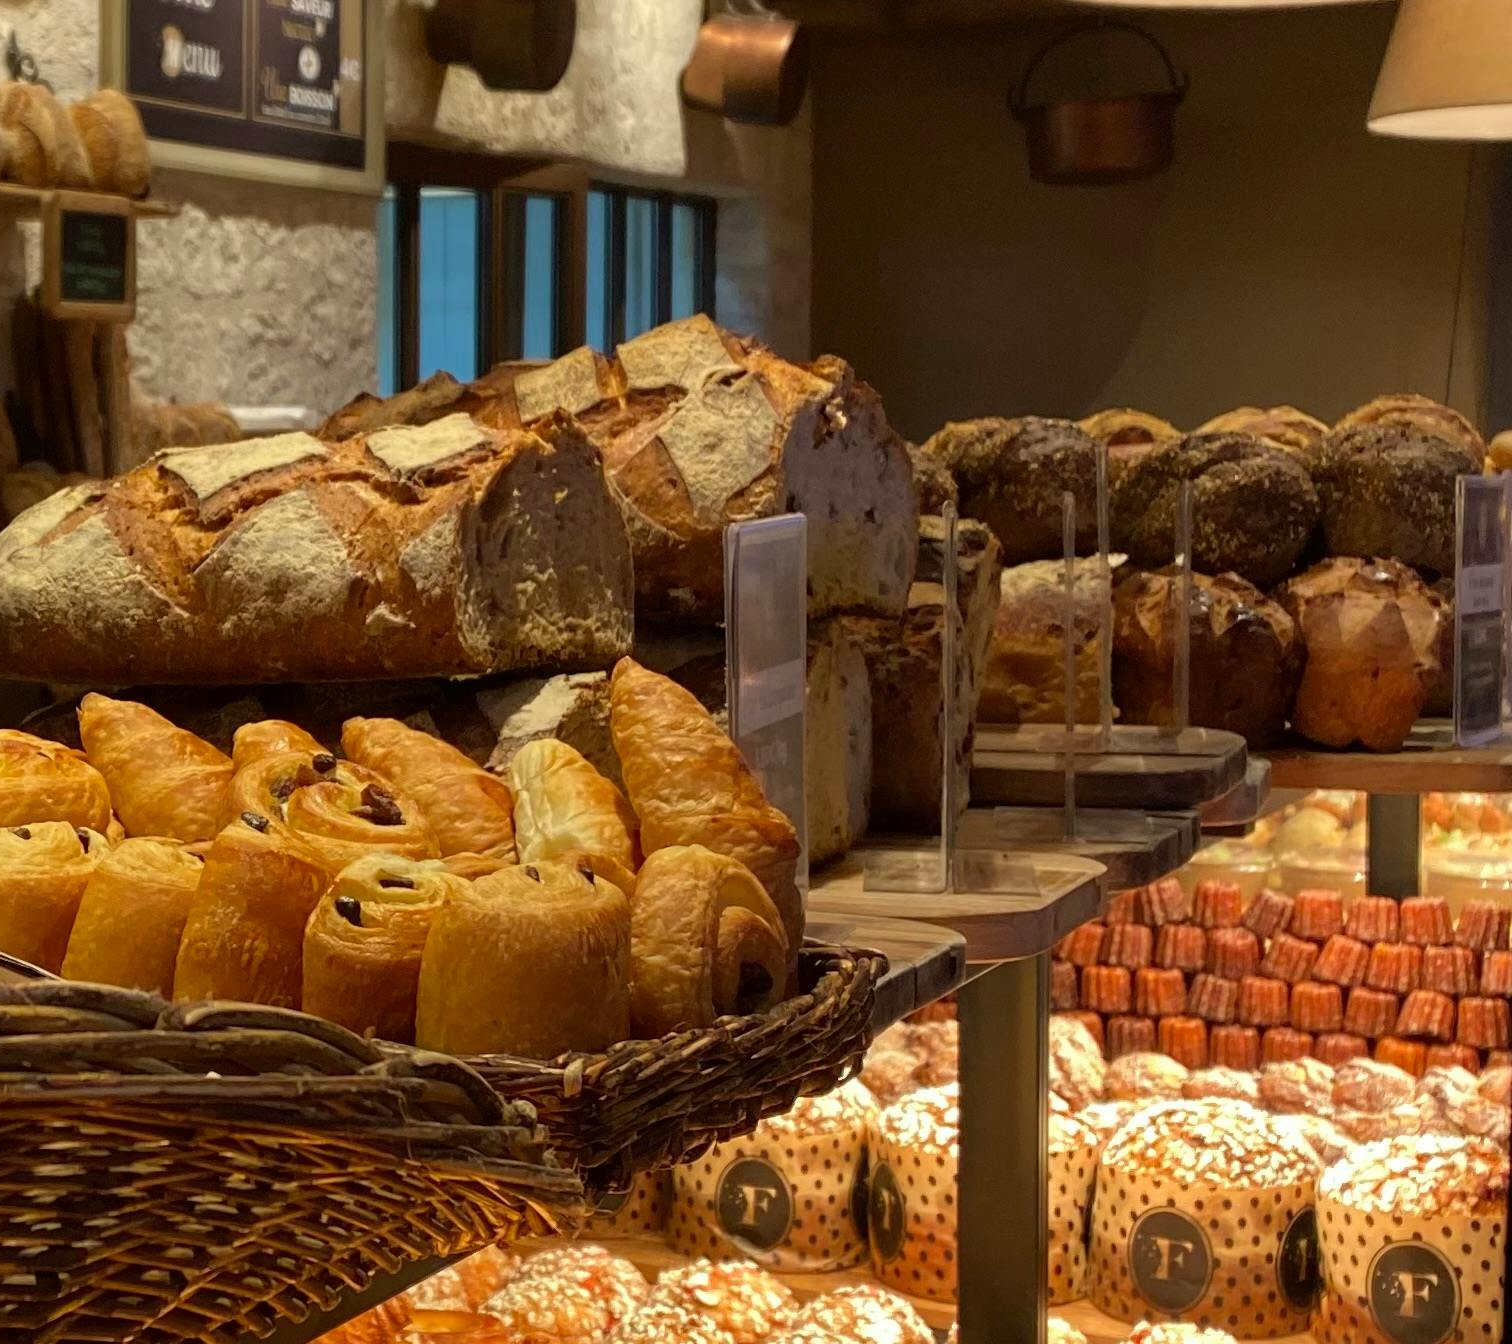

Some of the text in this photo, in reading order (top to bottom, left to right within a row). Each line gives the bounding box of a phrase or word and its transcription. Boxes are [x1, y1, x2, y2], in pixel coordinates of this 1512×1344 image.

[737, 1185, 777, 1226] F
[1148, 1236, 1194, 1282] F
[1391, 1271, 1439, 1319] F
